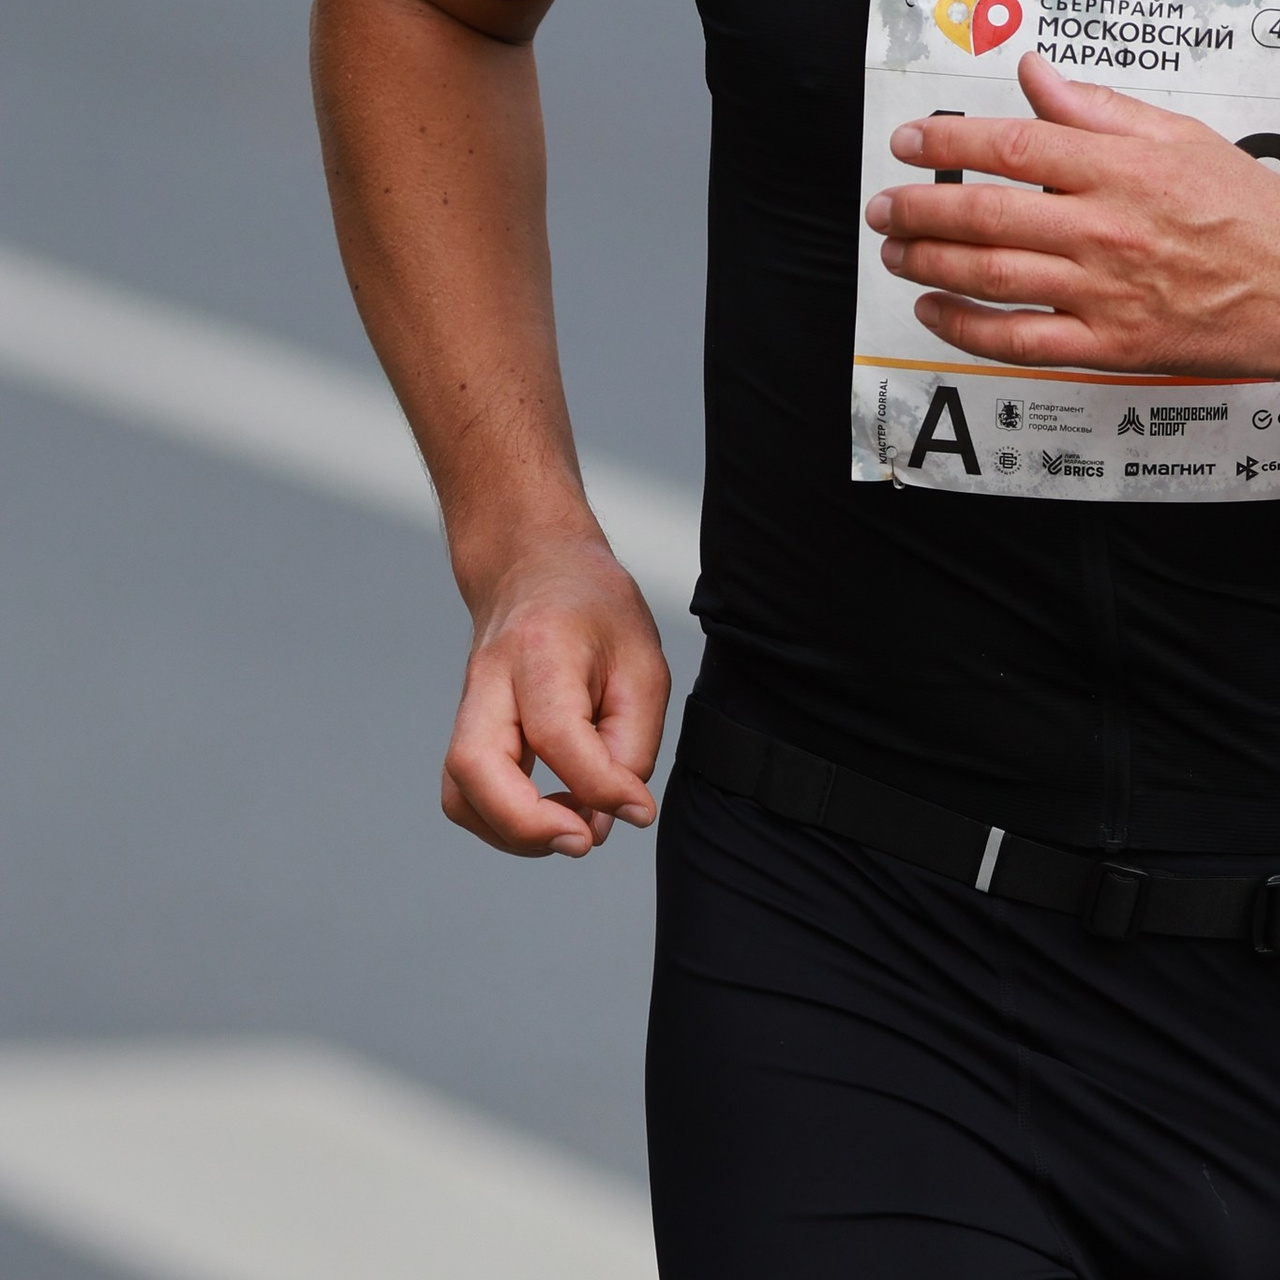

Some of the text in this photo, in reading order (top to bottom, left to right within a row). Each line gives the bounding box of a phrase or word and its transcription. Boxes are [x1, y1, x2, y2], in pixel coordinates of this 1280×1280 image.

[1038, 16, 1234, 50] МОСКОВСКИЙ
[1037, 42, 1180, 72] МАРАФОН
[878, 378, 889, 417] CORRAL
[1029, 402, 1084, 414] Департамент
[1150, 403, 1228, 421] МОСКОВСКИЙ
[1029, 413, 1058, 422] спорта
[908, 385, 982, 475] A
[1029, 423, 1093, 434] города Москвы
[1150, 422, 1187, 436] СПОРТ
[879, 424, 888, 464] КЛАСТЕР
[1064, 458, 1104, 466] МАРАФОНОВ
[1063, 465, 1104, 477] BRICS
[1142, 463, 1216, 476] магнит
